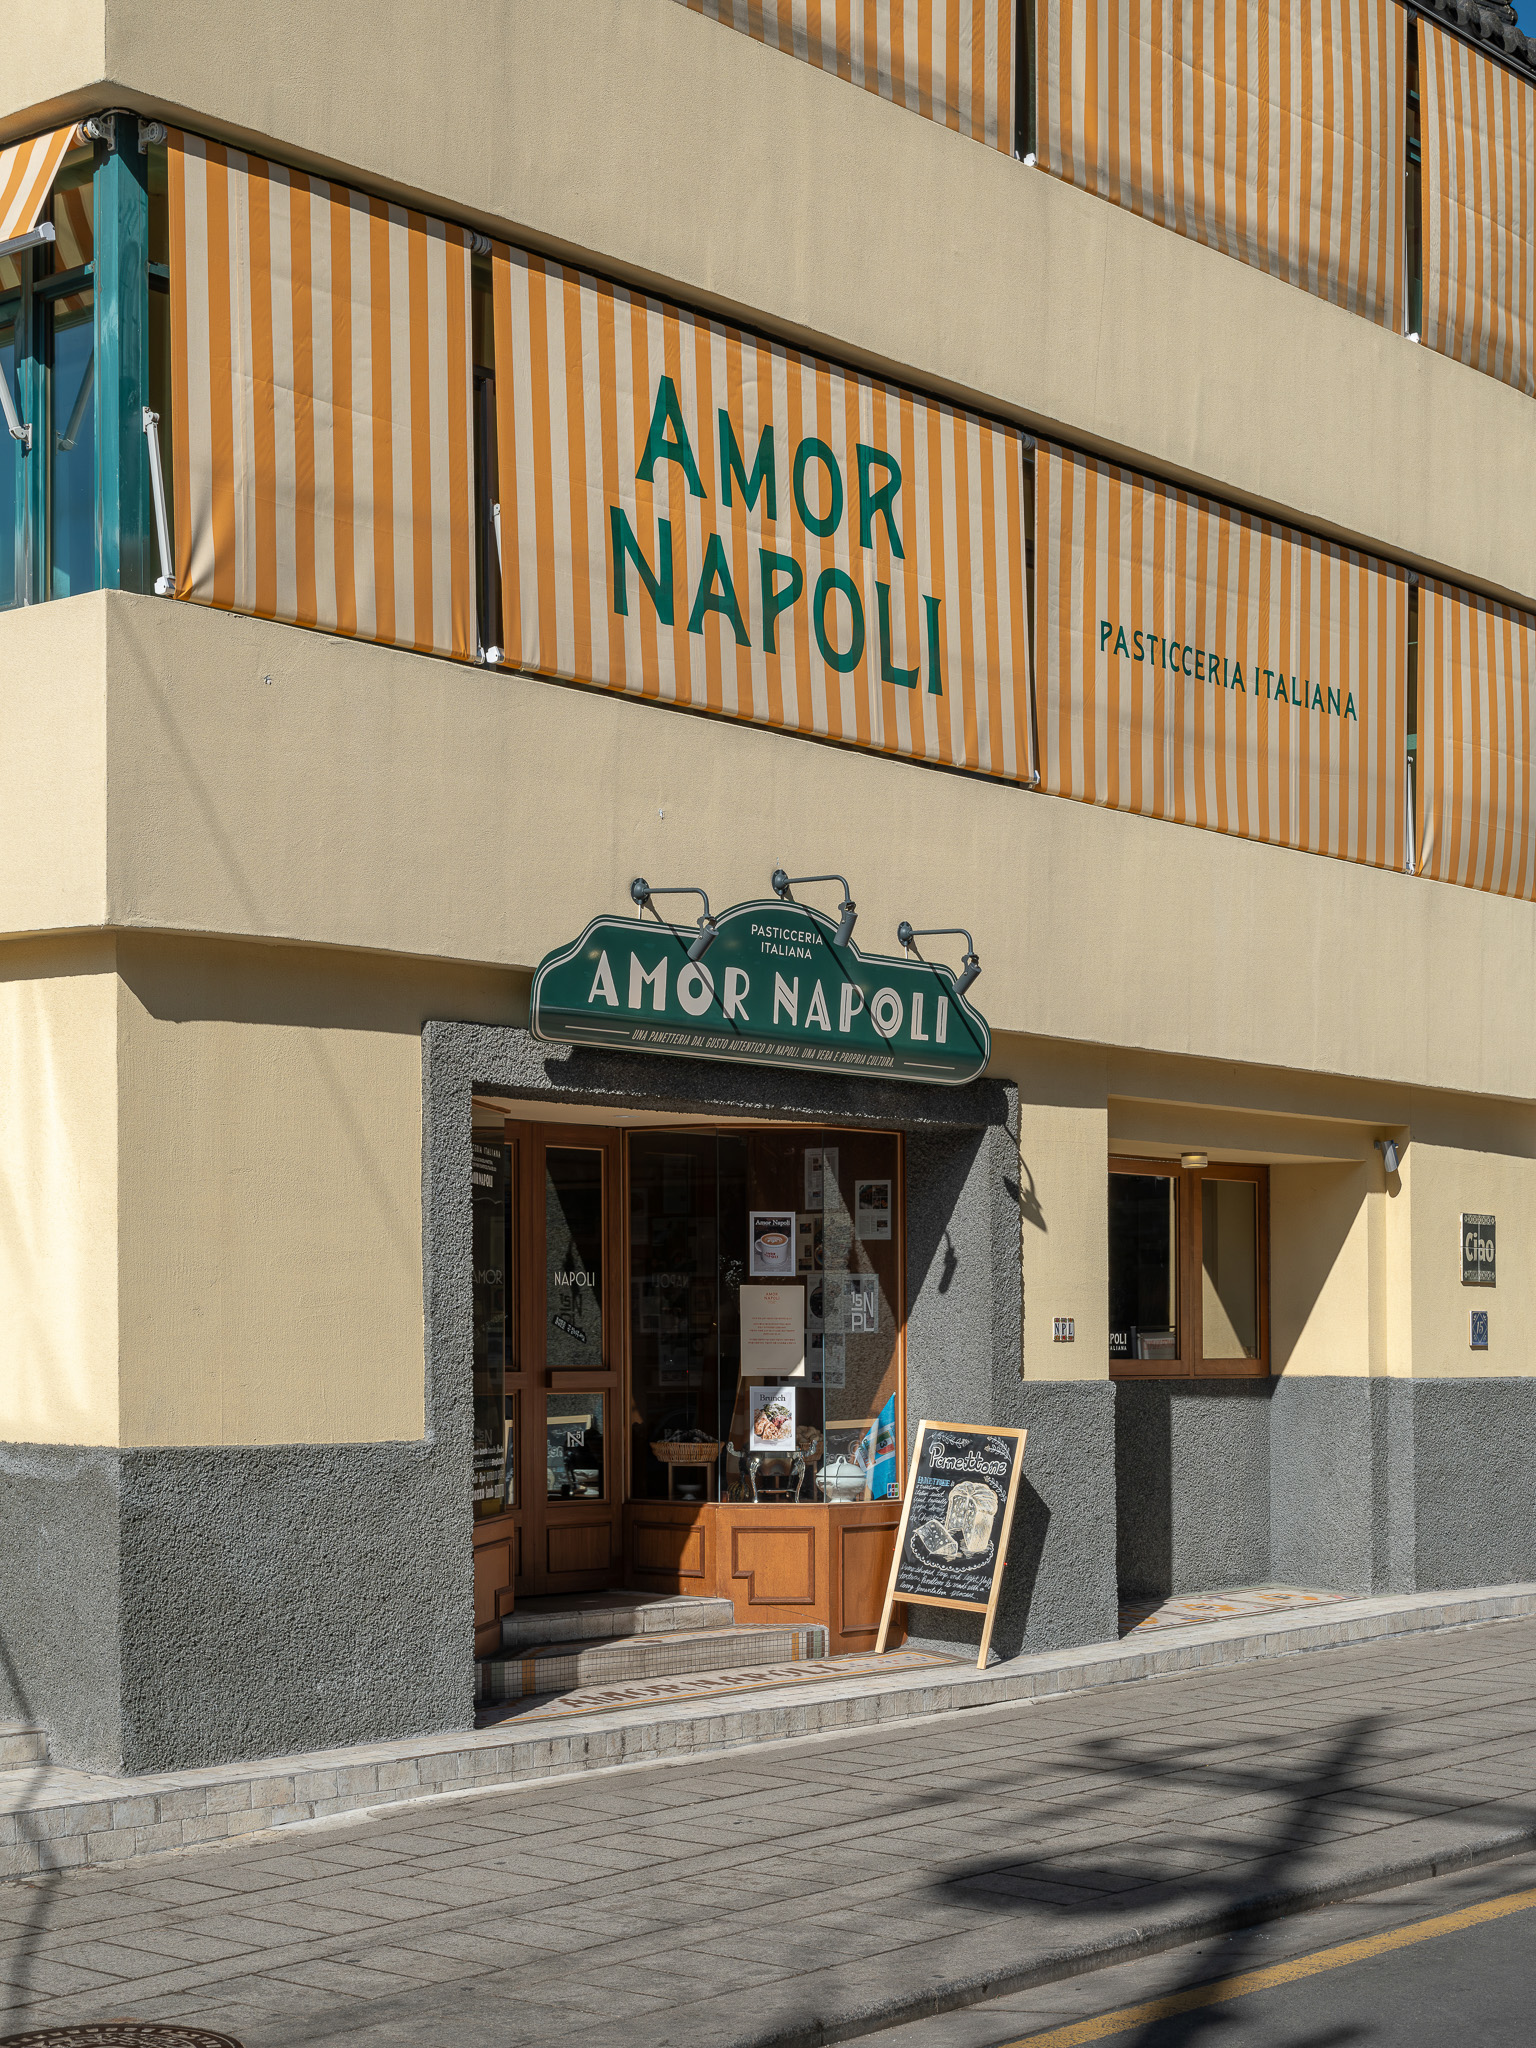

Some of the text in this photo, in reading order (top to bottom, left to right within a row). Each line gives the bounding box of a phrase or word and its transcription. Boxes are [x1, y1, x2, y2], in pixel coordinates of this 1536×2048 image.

[635, 375, 906, 560] AMOR
[610, 505, 943, 696] NAPOLI
[1100, 620, 1358, 721] PASTICCERIA ITALIANA
[751, 923, 823, 945] PASTICCERIA
[761, 941, 812, 960] ITALIANA
[588, 950, 948, 1043] AMOR NAPOLI
[631, 1029, 648, 1041] UNA
[648, 1031, 689, 1046] PANETTERIA
[691, 1035, 705, 1047] DAL
[705, 1037, 728, 1050] GUSTO
[728, 1039, 766, 1054] AUTENTICO
[765, 1043, 776, 1054] DI
[801, 1047, 815, 1059] UNA
[816, 1049, 834, 1061] VERA
[833, 1051, 840, 1062] E
[839, 1052, 866, 1065] PROPRIA
[772, 1219, 790, 1227] Napoli
[1465, 1231, 1495, 1263] Ciao
[554, 1271, 595, 1287] NAPOLI
[1475, 1320, 1484, 1335] 15
[760, 1394, 786, 1402] Brunch
